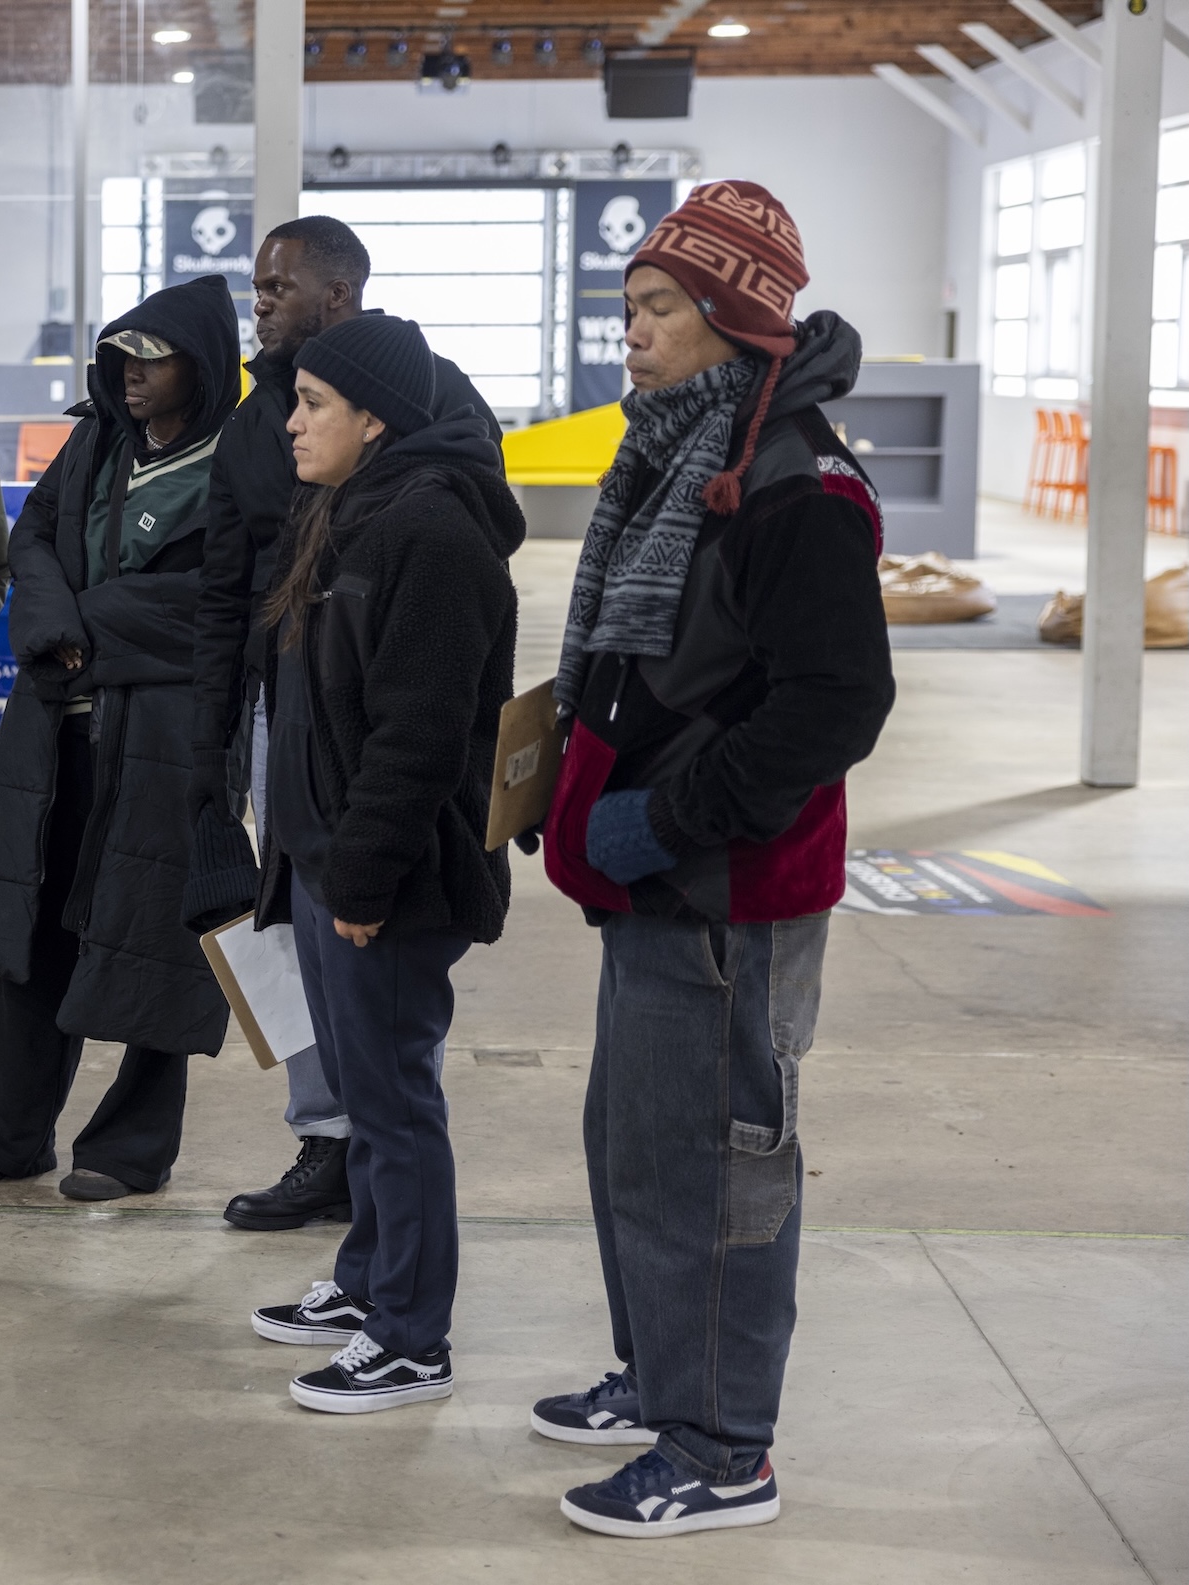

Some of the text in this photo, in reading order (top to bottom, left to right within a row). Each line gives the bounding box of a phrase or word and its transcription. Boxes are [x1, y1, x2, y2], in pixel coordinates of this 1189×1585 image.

[578, 316, 625, 340] WO
[577, 340, 628, 365] WA
[671, 1480, 701, 1495] Reebok
